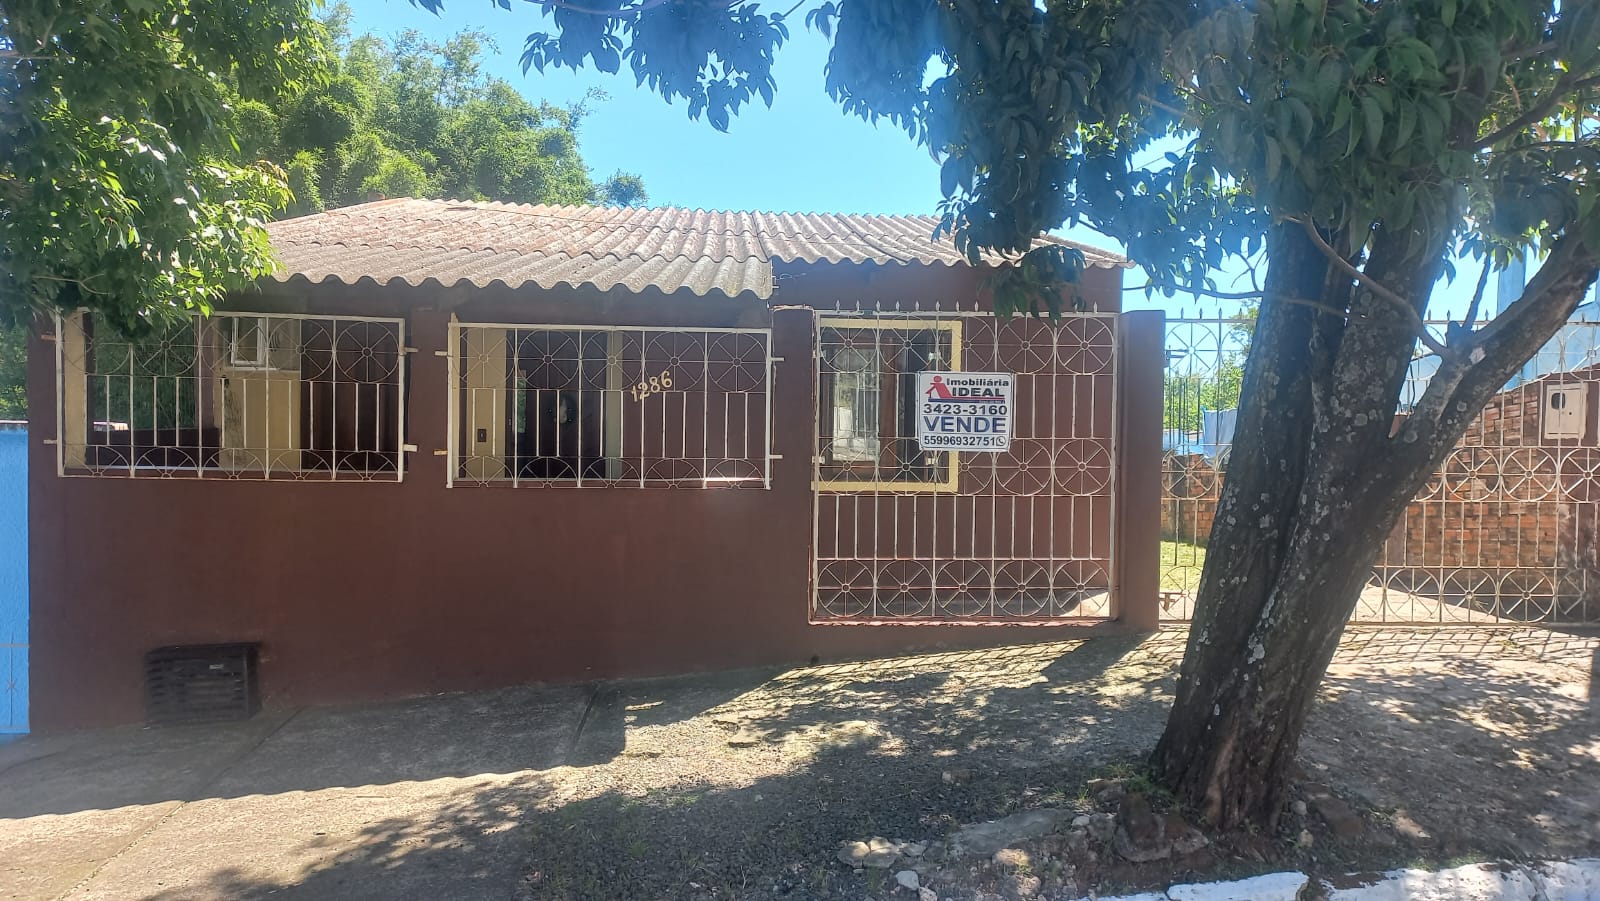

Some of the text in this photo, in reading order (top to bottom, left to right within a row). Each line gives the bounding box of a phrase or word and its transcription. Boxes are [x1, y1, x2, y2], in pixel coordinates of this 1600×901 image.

[631, 370, 673, 402] 1286
[946, 378, 1009, 387] Imobiliária
[952, 387, 1005, 397] IDEAL
[923, 403, 1008, 415] 3423-3160
[923, 416, 1006, 433] VENDE
[924, 435, 995, 446] 55996932751
